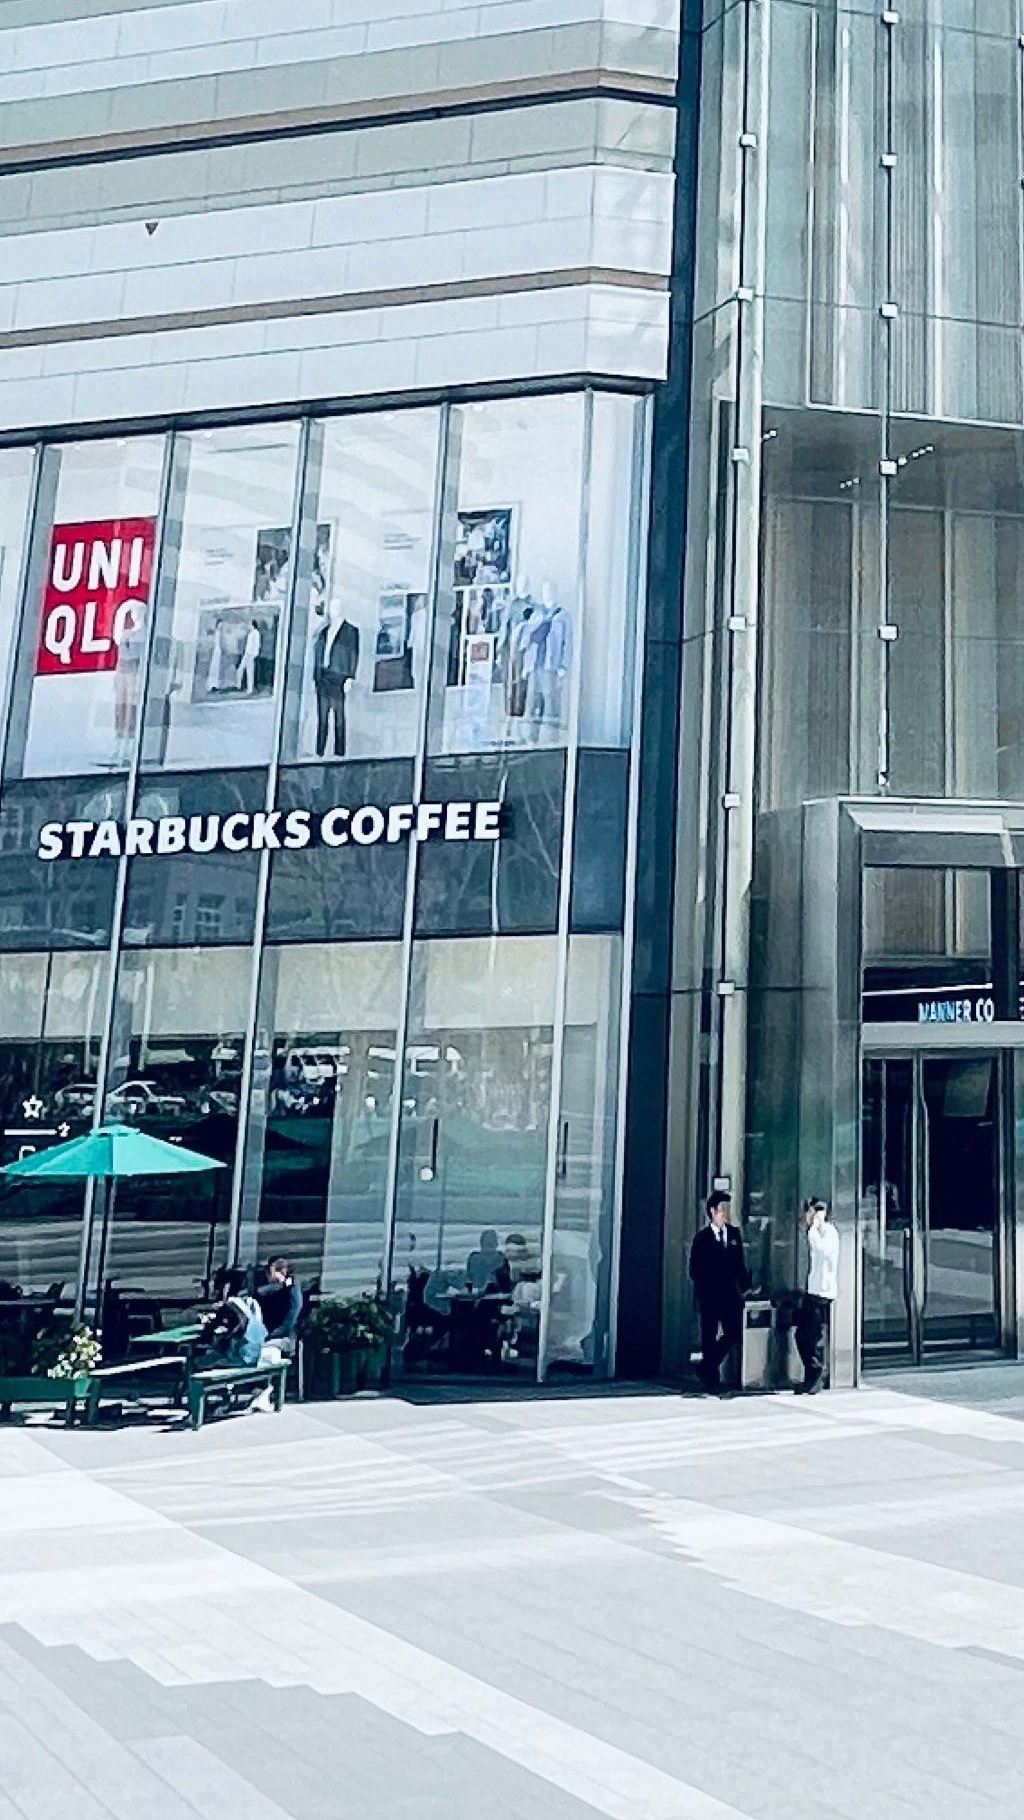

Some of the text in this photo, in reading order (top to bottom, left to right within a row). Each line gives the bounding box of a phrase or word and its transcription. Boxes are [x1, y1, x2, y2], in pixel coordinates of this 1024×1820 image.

[52, 537, 145, 592] UNI
[37, 801, 501, 860] STARBUCKS COFFEE
